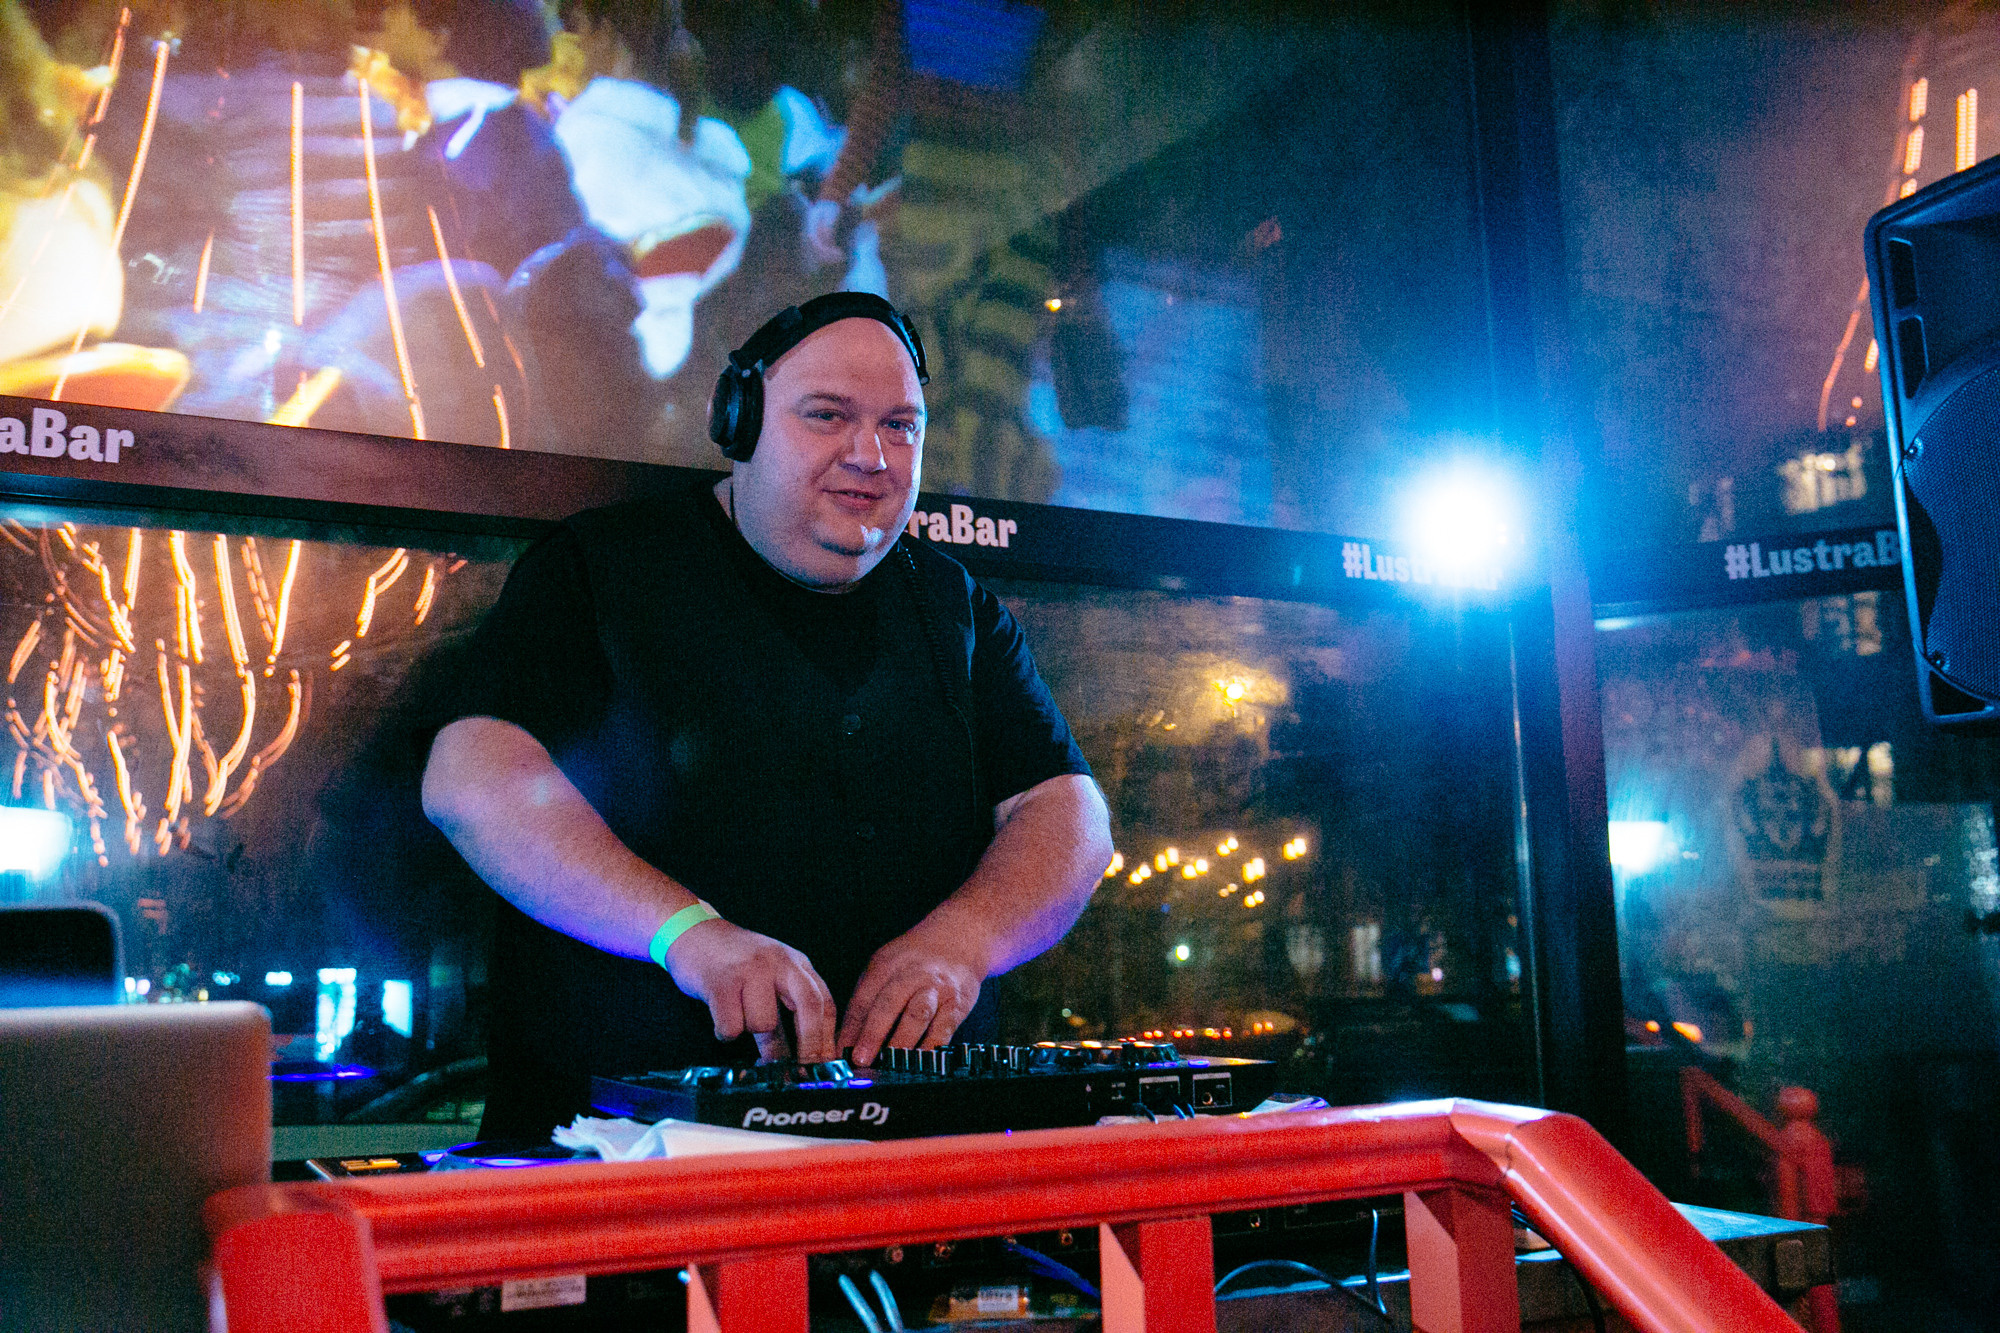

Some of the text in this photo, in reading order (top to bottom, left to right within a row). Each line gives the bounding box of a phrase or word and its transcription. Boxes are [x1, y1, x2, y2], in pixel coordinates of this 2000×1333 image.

[0, 407, 135, 464] aBar
[903, 503, 1018, 548] raBar
[1724, 530, 1900, 580] #LustraB
[742, 1106, 855, 1128] Pioneer
